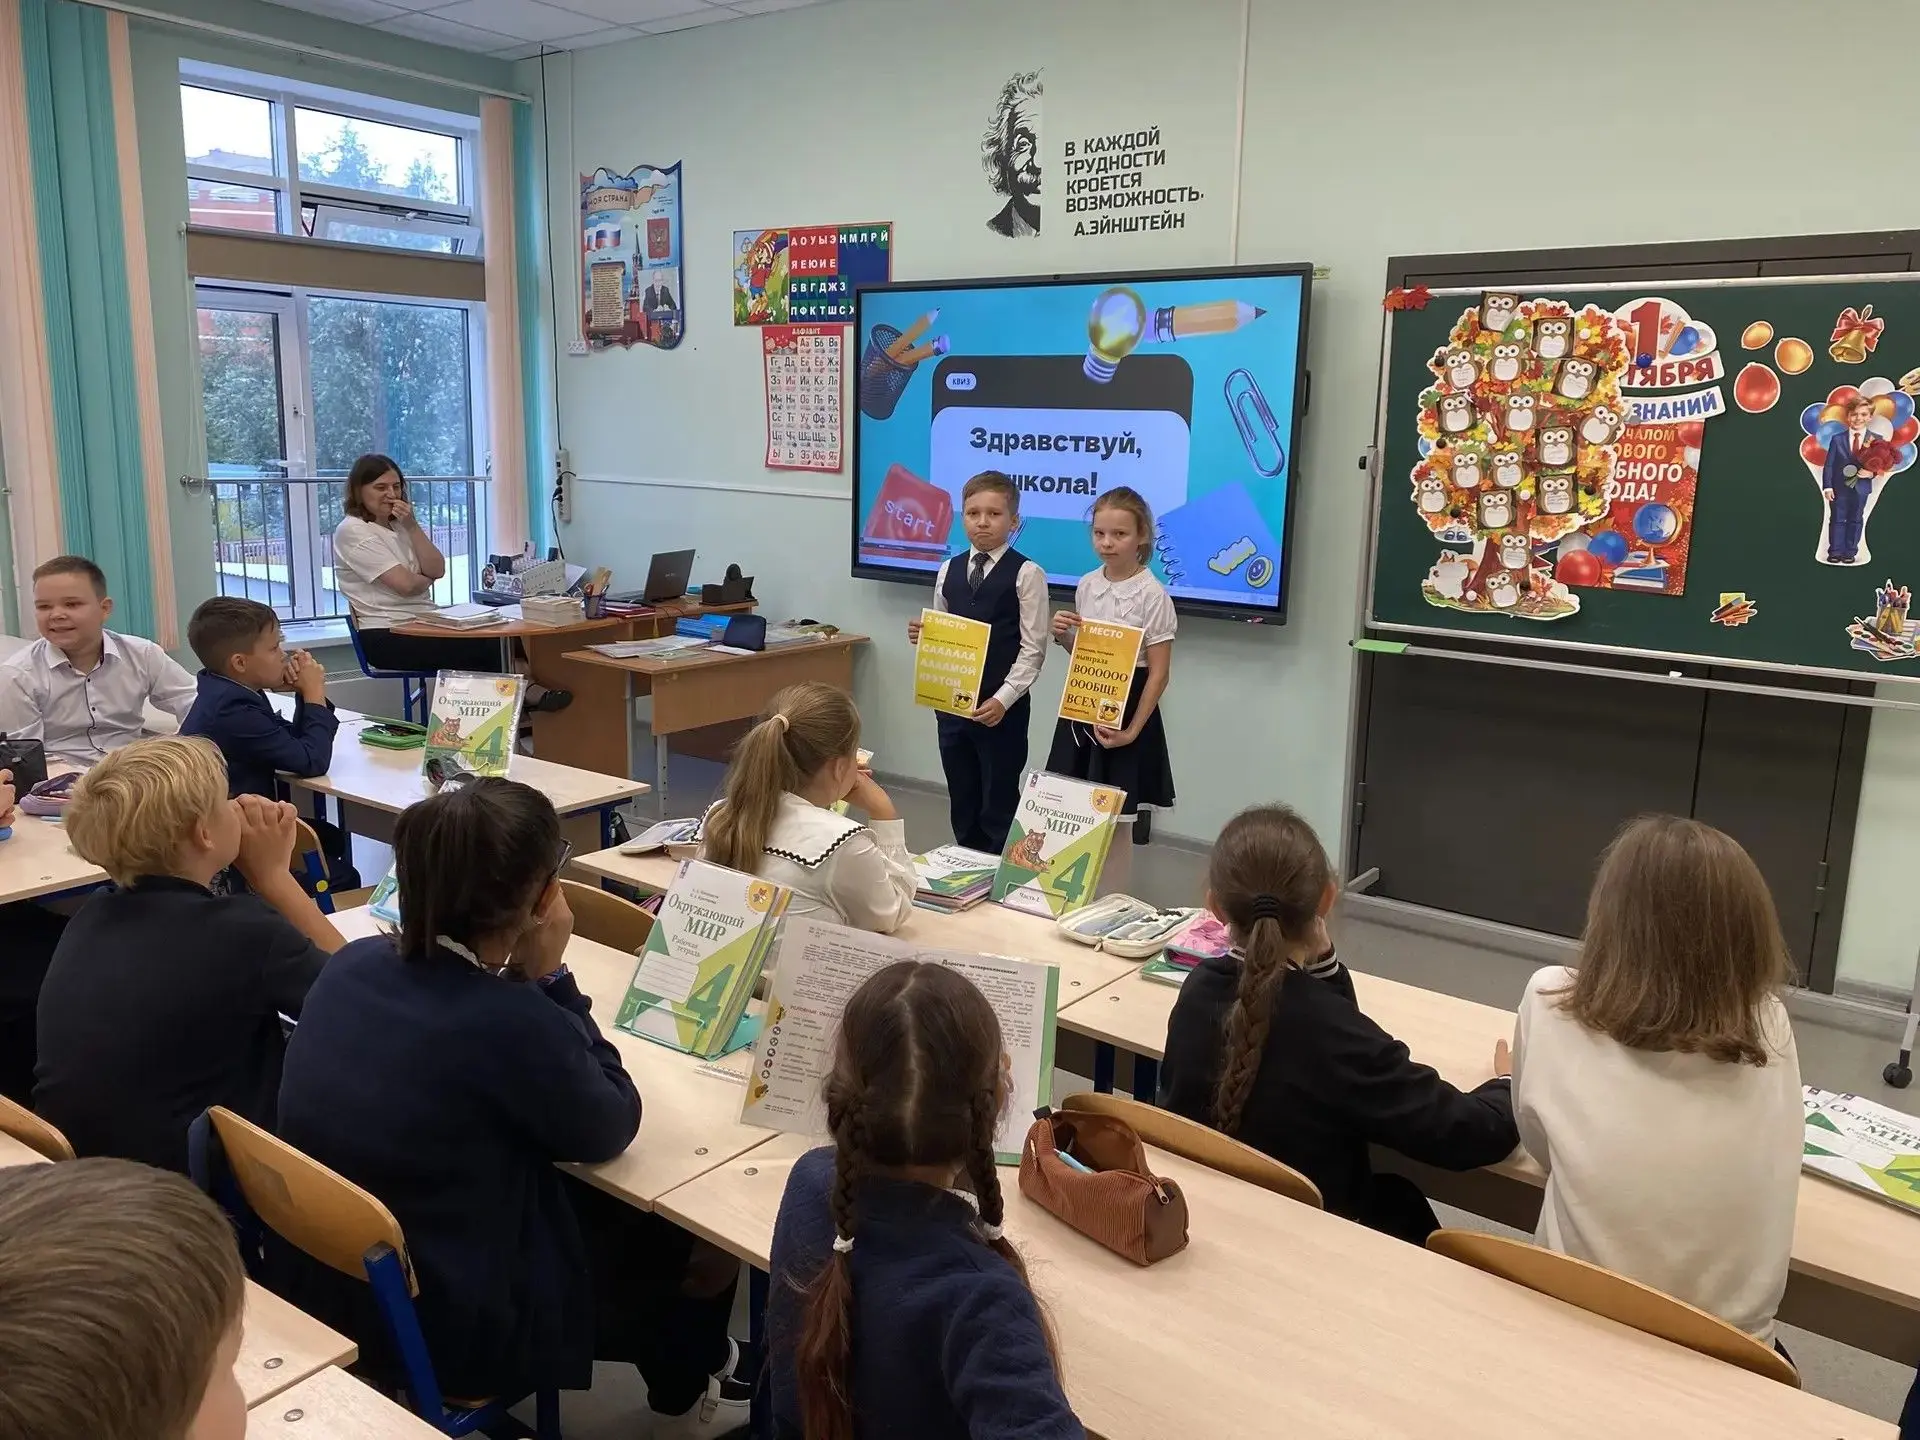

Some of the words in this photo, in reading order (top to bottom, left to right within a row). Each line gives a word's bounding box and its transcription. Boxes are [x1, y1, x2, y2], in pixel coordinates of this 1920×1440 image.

[1065, 141, 1076, 157] В
[1084, 126, 1161, 154] КАЖДОЙ
[1064, 150, 1166, 175] ТРУДНОСТИ
[1066, 172, 1142, 195] КРОЕТСЯ
[1073, 210, 1185, 237] А.ЭЙНШТЕЙН
[1631, 301, 1662, 362] 1
[1628, 357, 1715, 386] ТЯБРЯ
[1632, 390, 1717, 419] ЗНАНИЙ
[970, 427, 1142, 461] Здравствуй,
[1623, 428, 1675, 441] ЧАЛОМ
[1613, 443, 1667, 460] ОВОГО
[1616, 461, 1683, 483] БНОГО
[1610, 481, 1658, 502] ОДА!
[885, 500, 936, 537] start
[1089, 627, 1124, 639] МЕСТО
[438, 696, 502, 707] Окружающий
[458, 706, 491, 717] МИР
[1067, 693, 1097, 709] ВСЕХ
[475, 726, 504, 764] 4
[1025, 799, 1095, 825] Окружающий
[1044, 817, 1081, 837] МИР
[1052, 852, 1091, 904] 4
[668, 893, 745, 928] Окружающий
[684, 915, 727, 942] МИР
[686, 963, 735, 1026] 4
[1830, 1104, 1920, 1141] Окружаю
[1865, 1125, 1920, 1150] МИ
